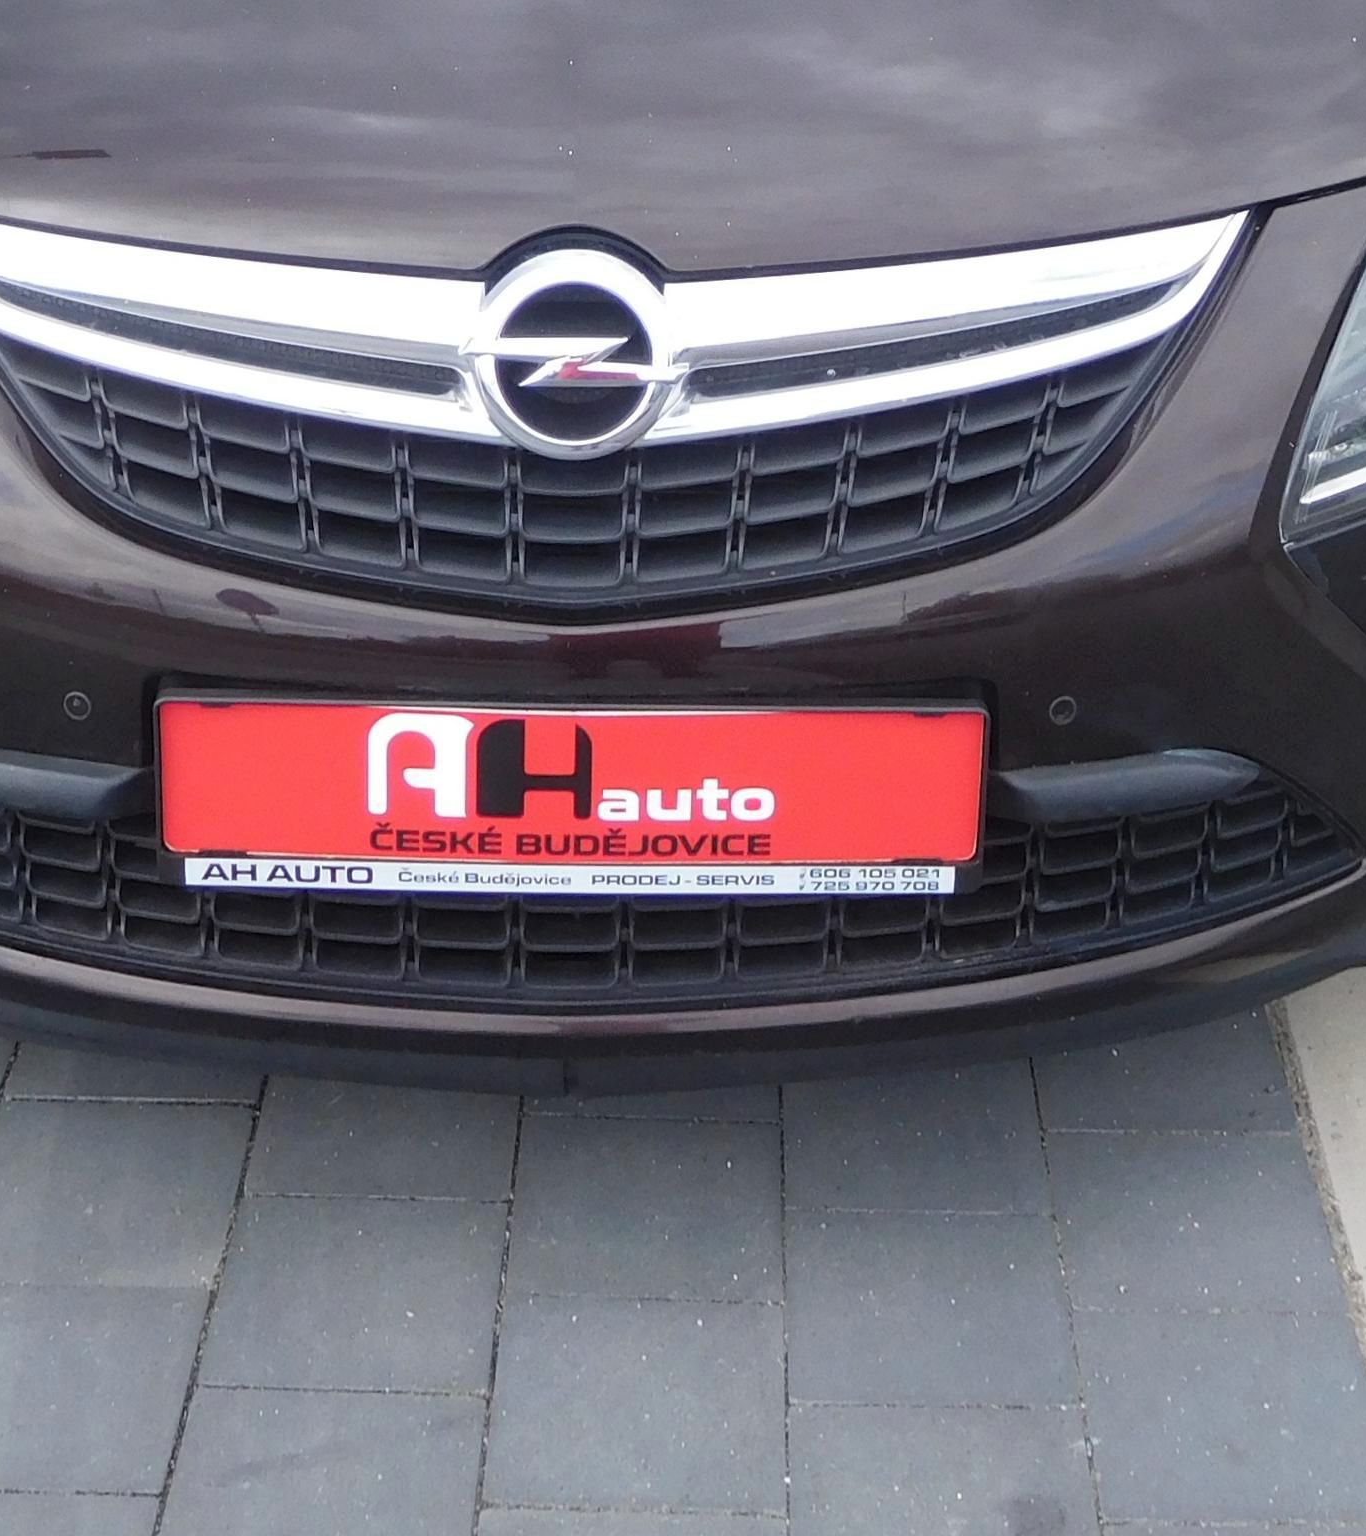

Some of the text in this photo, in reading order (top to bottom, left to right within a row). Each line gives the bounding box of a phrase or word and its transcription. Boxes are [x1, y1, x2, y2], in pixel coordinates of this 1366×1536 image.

[370, 822, 772, 857] ČESKÉ BUDĚJOVICE
[201, 863, 257, 881] AH
[266, 864, 374, 885] AUTO
[398, 867, 459, 884] České
[464, 871, 572, 887] Budějovice
[591, 874, 681, 886] PRODEJ
[696, 874, 775, 887] SERVIS
[858, 868, 896, 879] 105
[901, 881, 940, 892] 708
